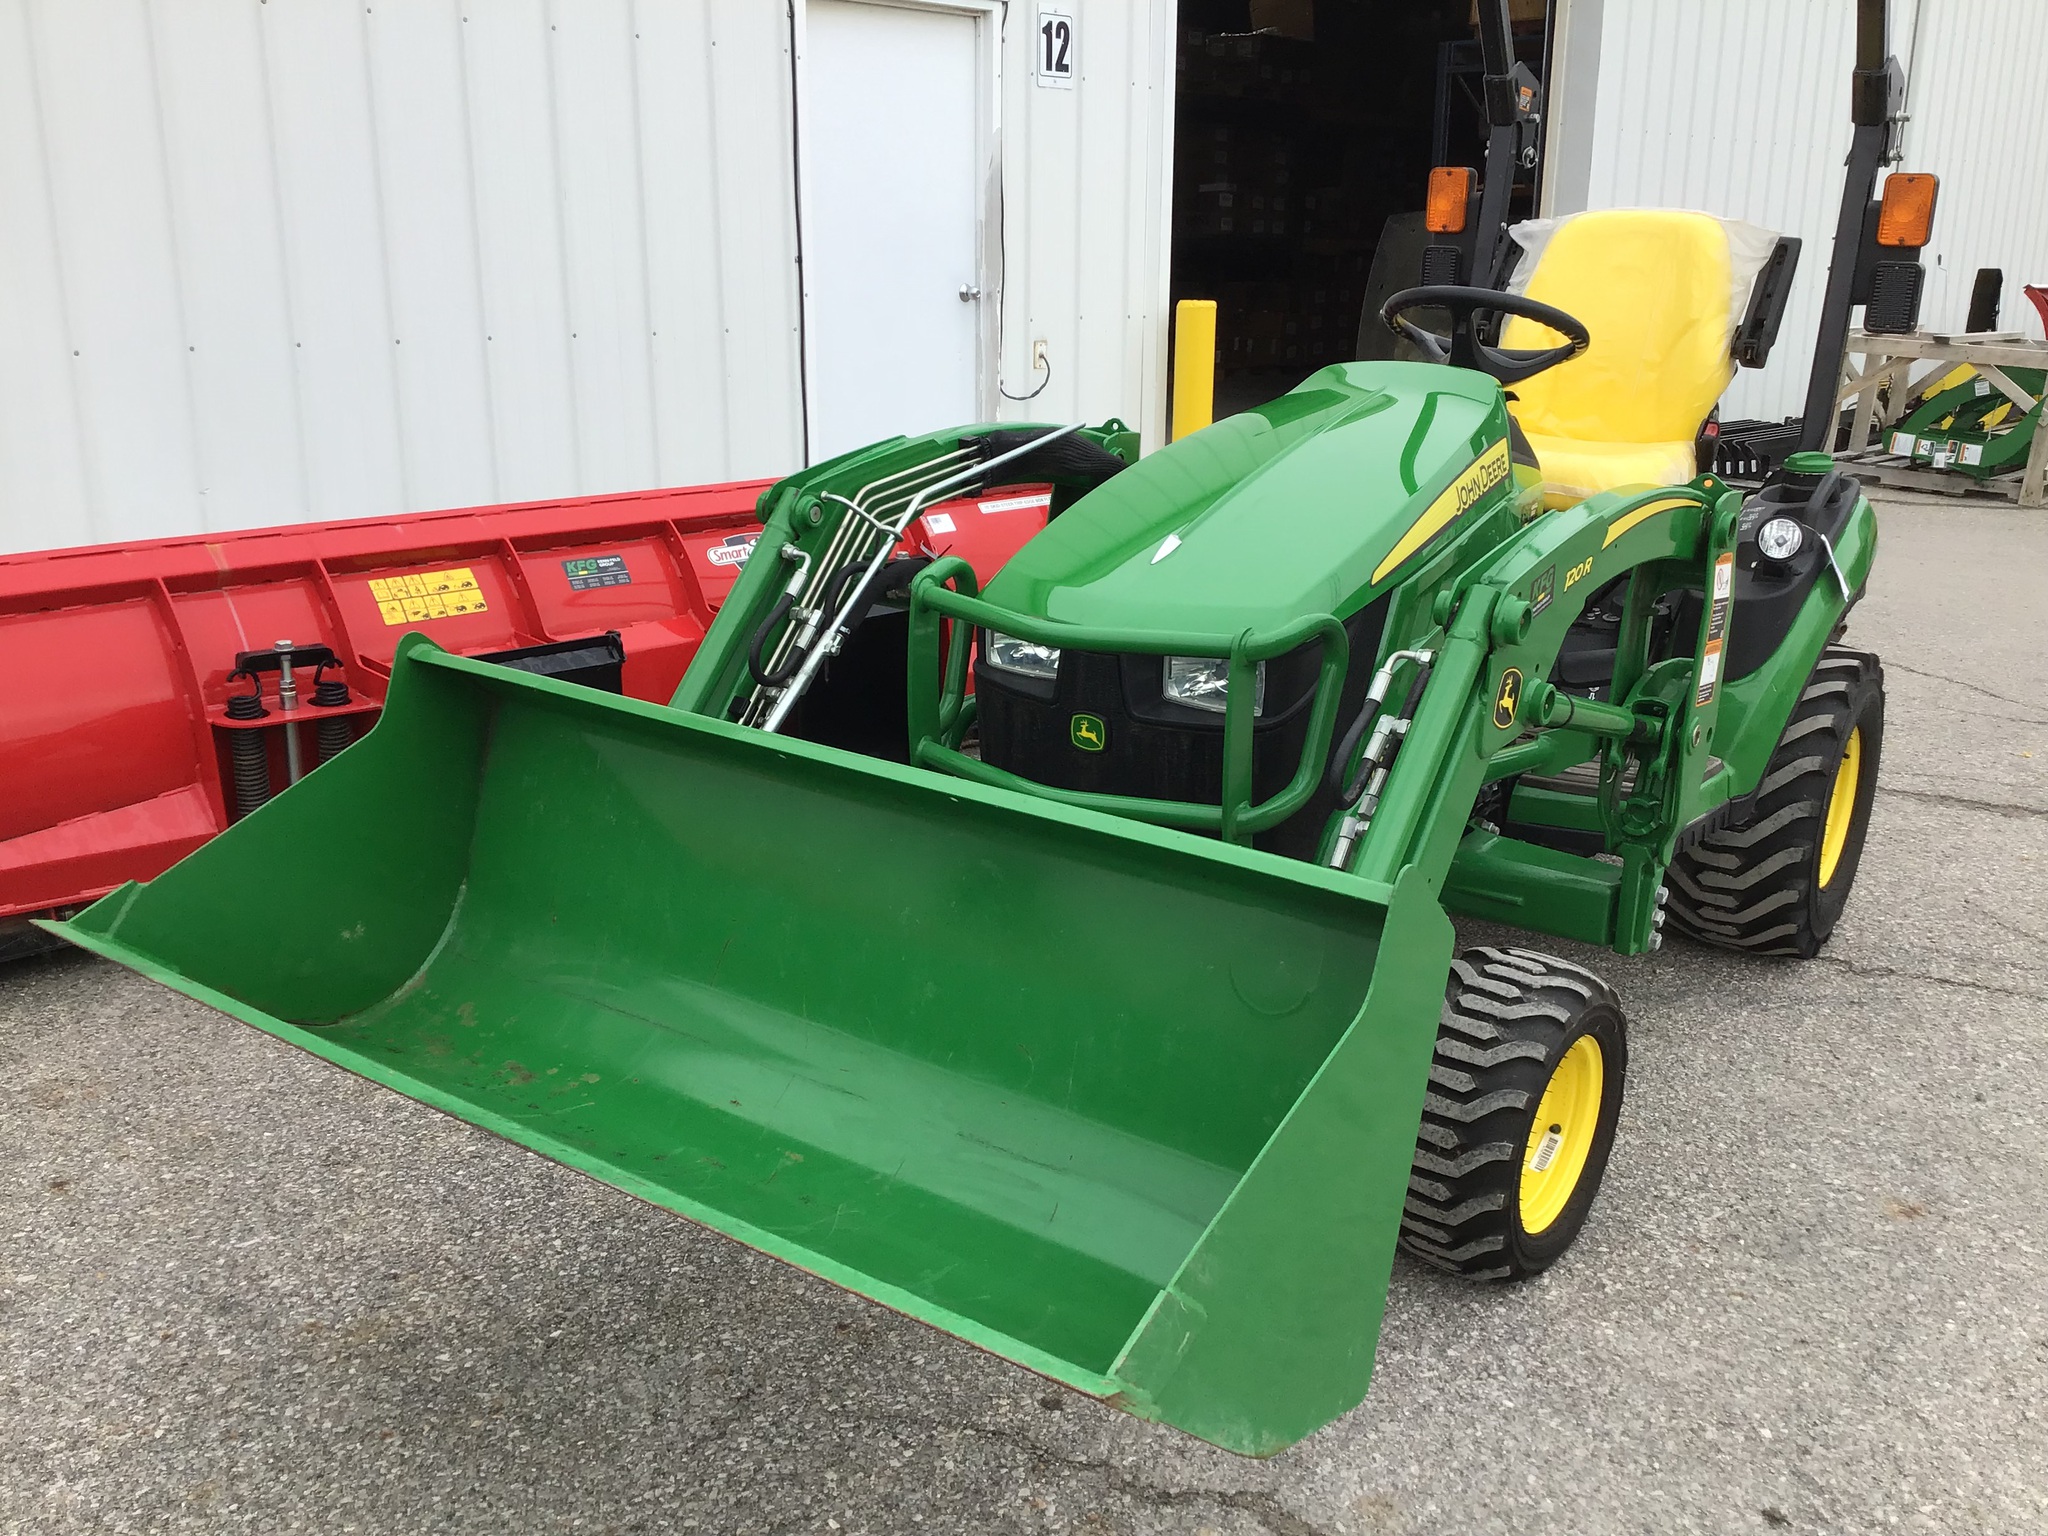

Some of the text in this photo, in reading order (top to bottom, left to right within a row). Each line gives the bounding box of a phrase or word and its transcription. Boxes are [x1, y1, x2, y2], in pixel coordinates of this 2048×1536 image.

[1042, 20, 1070, 73] 12
[1455, 453, 1507, 512] JOHN DEERE
[566, 559, 598, 573] KFG
[713, 546, 748, 562] Smart
